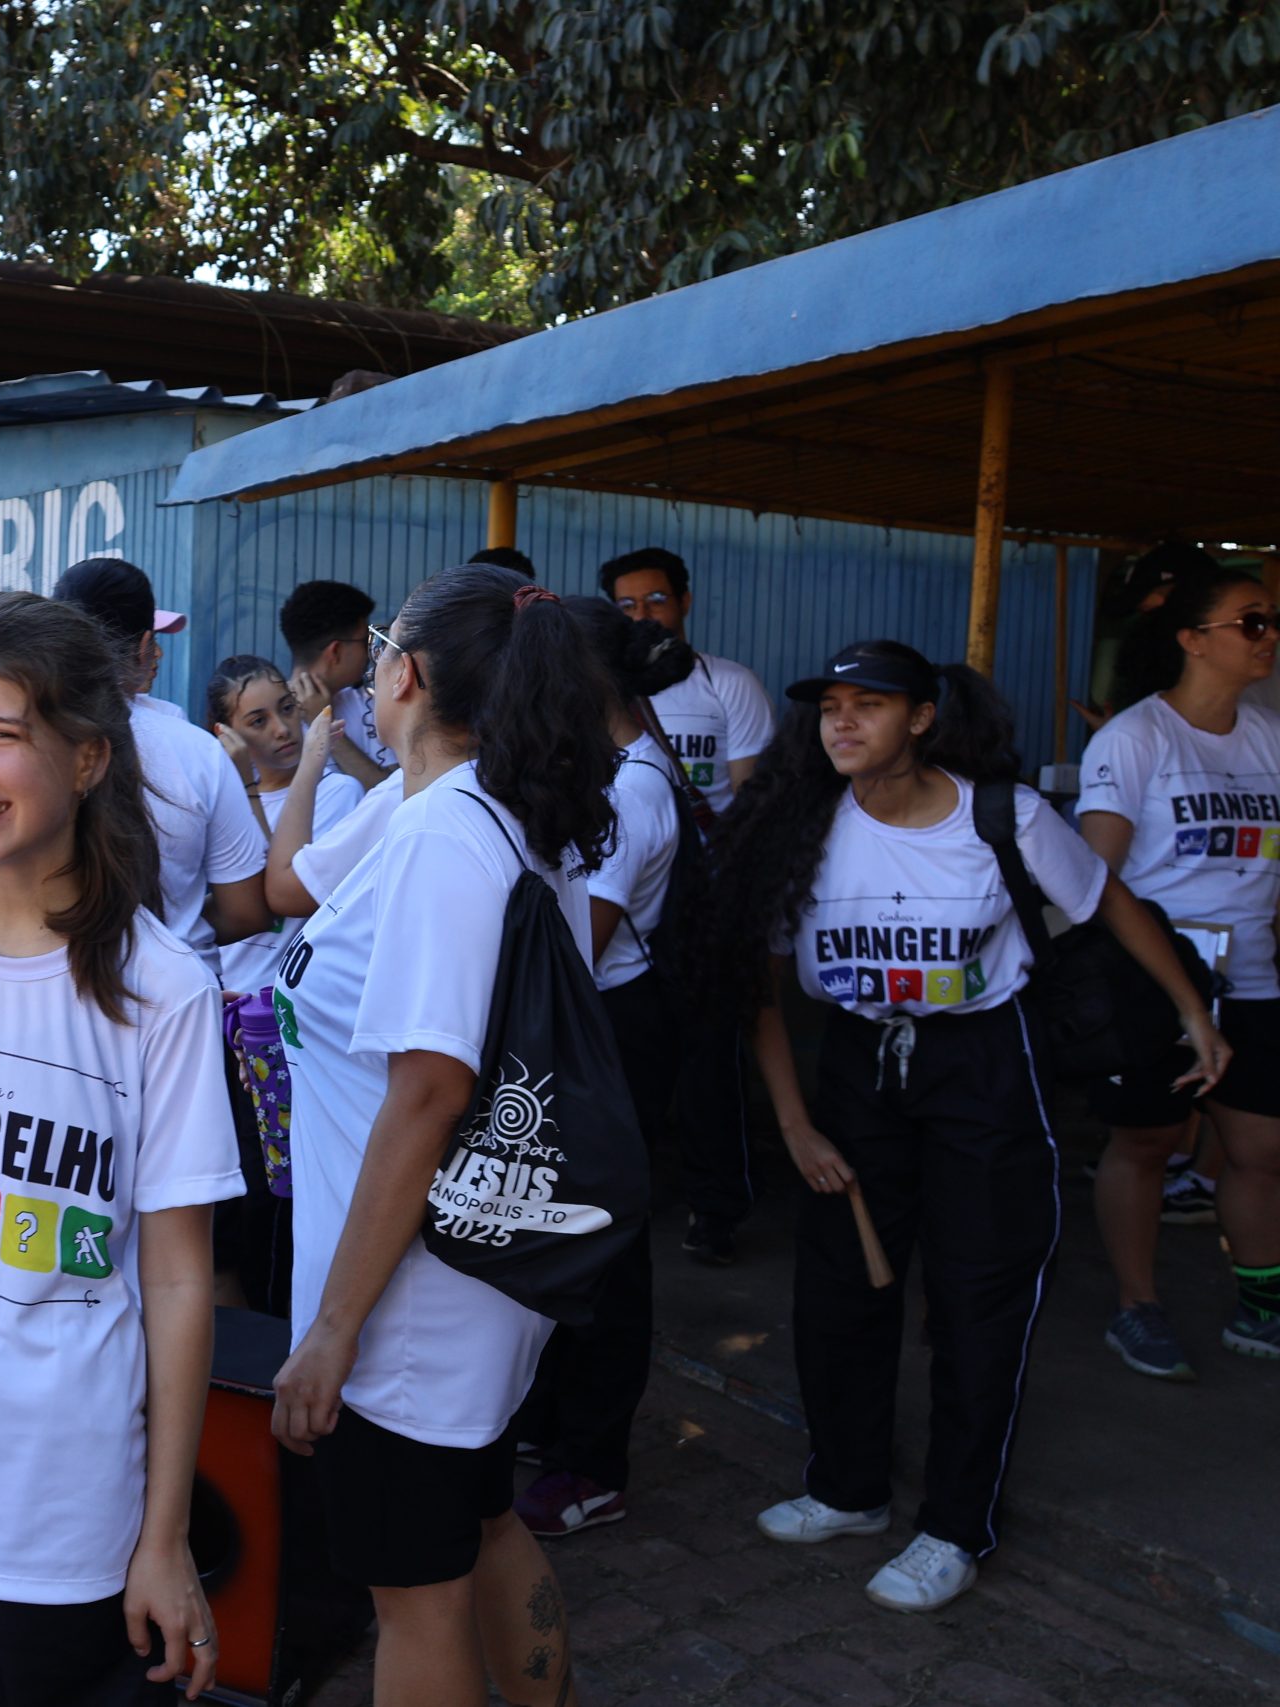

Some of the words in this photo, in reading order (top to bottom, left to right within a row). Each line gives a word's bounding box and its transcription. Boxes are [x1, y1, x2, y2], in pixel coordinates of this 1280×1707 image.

[431, 1177, 523, 1220] ANÓPOLIS
[541, 1209, 567, 1224] TO
[434, 1206, 513, 1248] 2025
